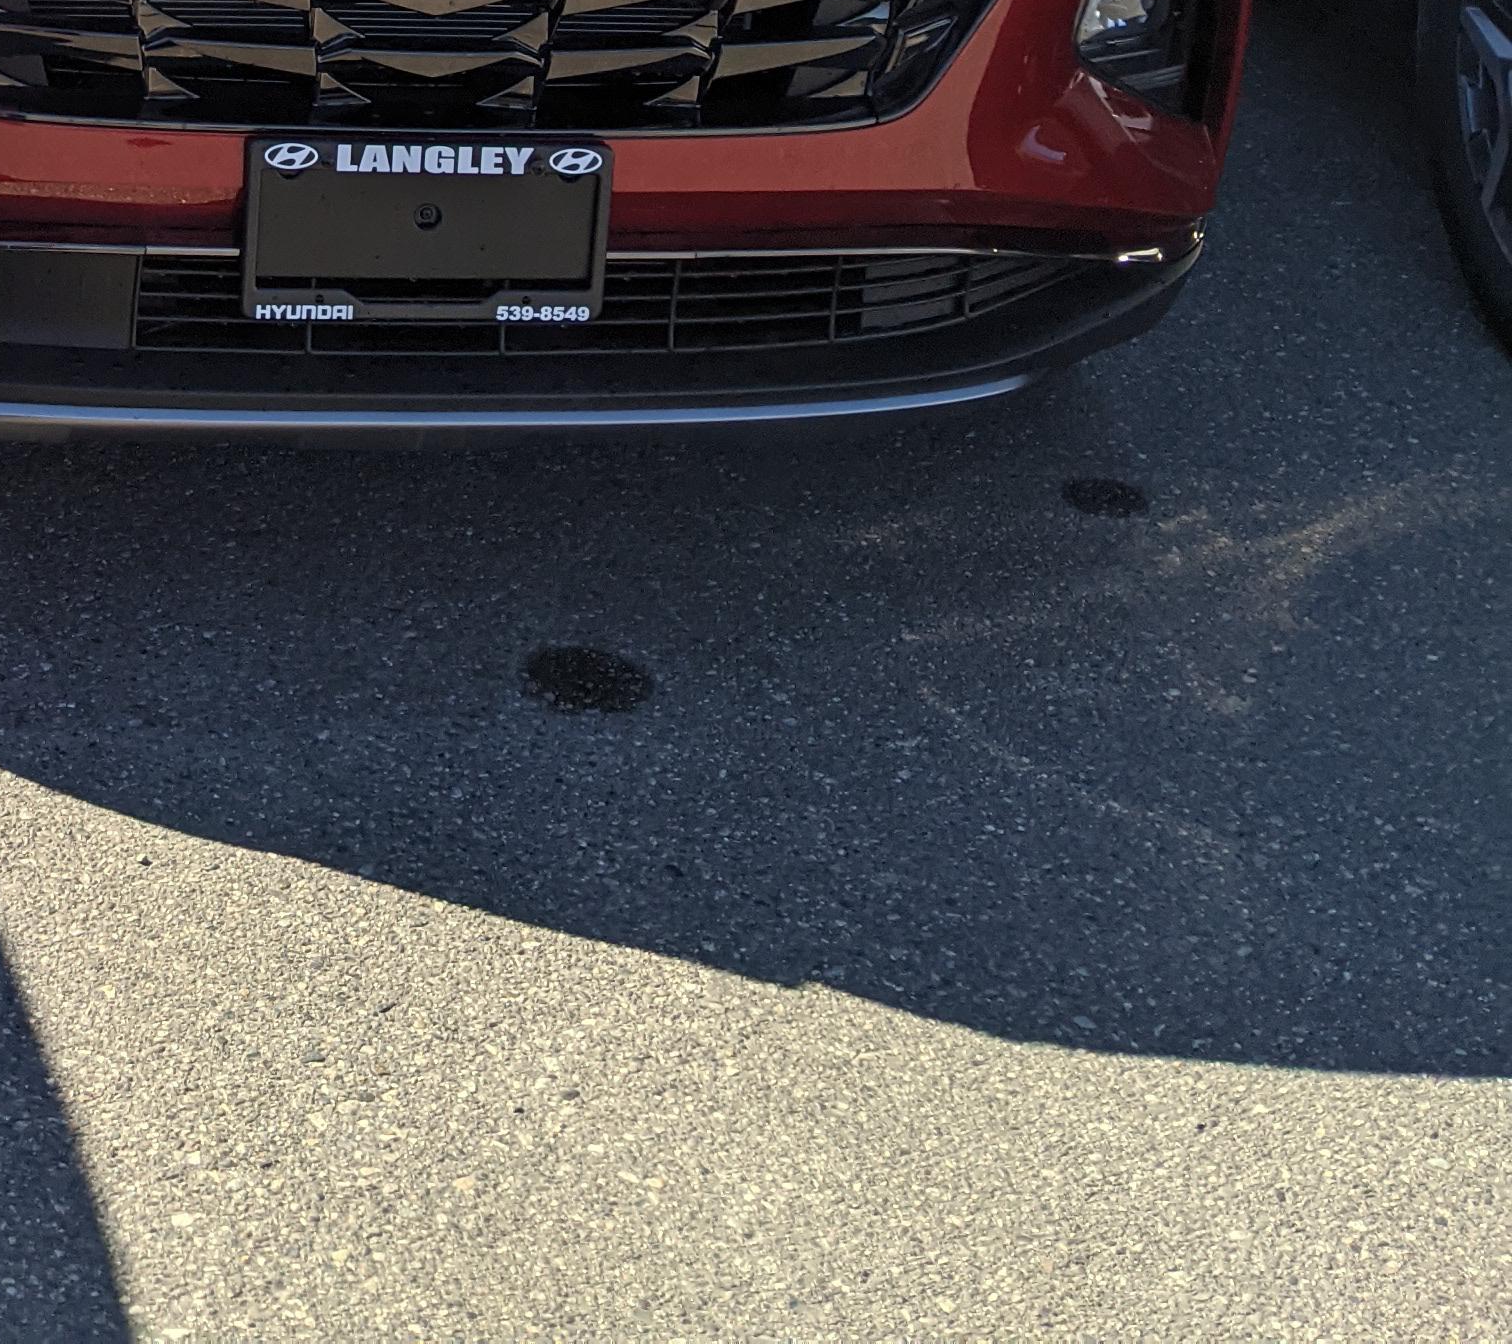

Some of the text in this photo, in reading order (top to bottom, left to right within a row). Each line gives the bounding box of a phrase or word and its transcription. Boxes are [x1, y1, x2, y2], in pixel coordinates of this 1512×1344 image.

[336, 143, 535, 175] LANGLEY
[255, 304, 354, 320] HYUNDAI
[495, 305, 590, 322] 539-8549
